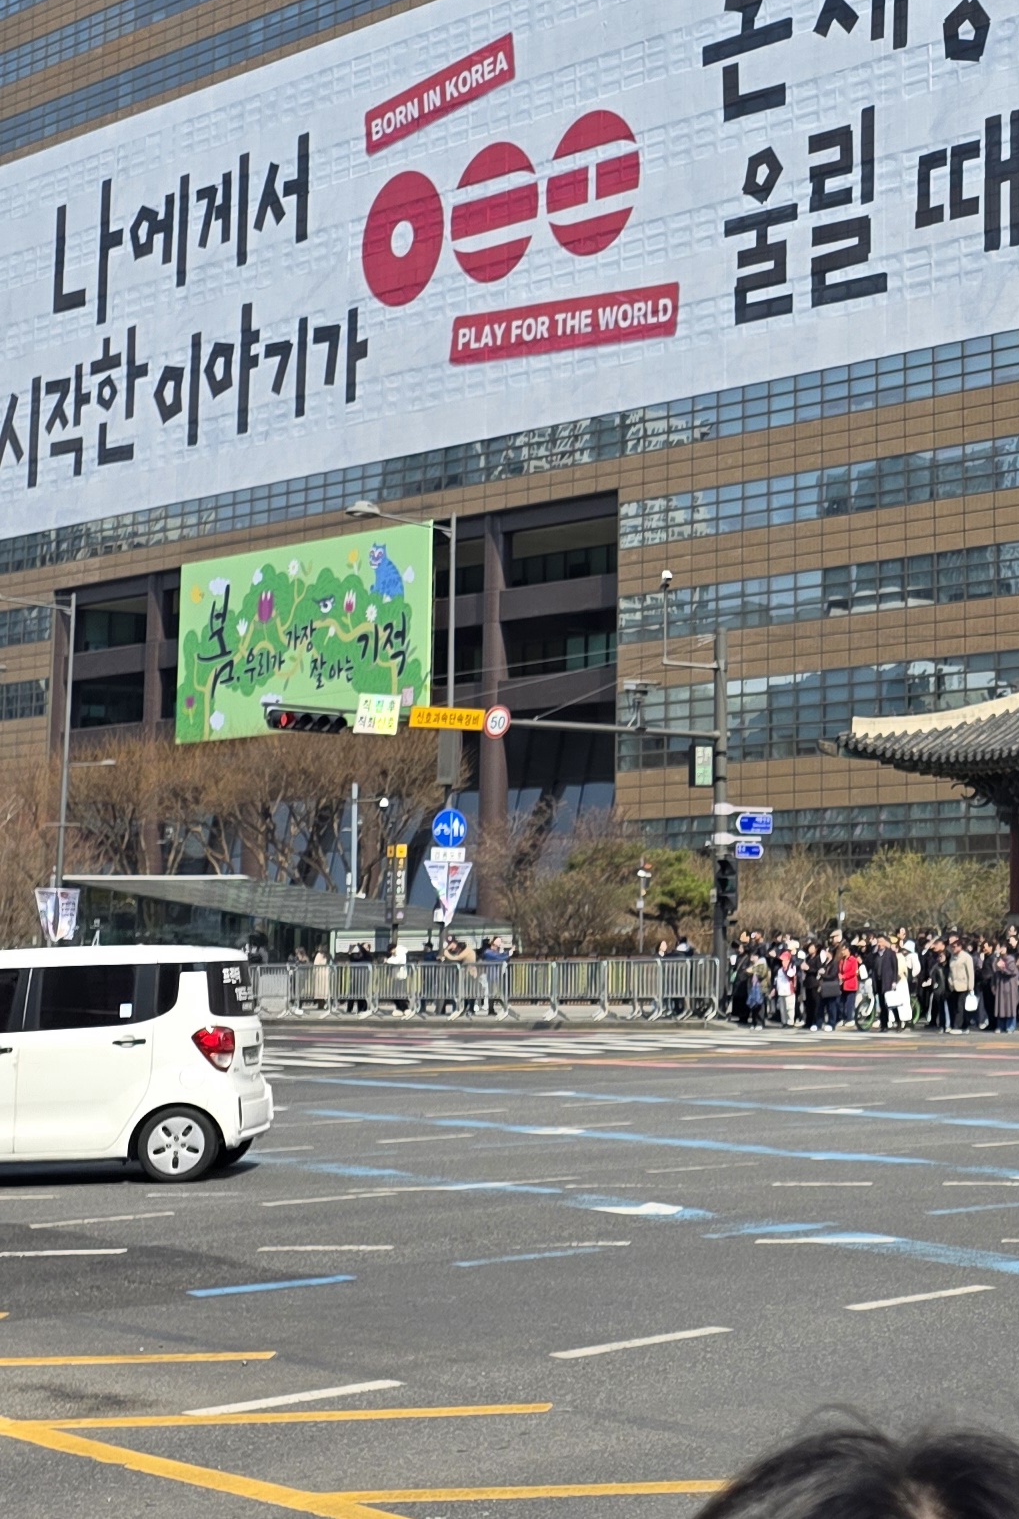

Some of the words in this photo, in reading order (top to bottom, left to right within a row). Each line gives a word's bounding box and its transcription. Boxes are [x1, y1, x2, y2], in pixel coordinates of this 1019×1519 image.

[371, 97, 420, 142] BORN
[423, 85, 441, 114] IN
[445, 50, 509, 102] KOREA
[53, 132, 310, 325] 나에게서
[724, 104, 889, 327] 울릴
[457, 321, 506, 351] PLAY
[510, 315, 550, 344] FOR
[554, 309, 593, 336] THE
[597, 297, 673, 331] WORLD
[0, 325, 149, 488] 시작한
[153, 302, 369, 446] 이야기가
[244, 647, 285, 685] 우리가
[285, 619, 317, 652] 가장
[356, 611, 407, 678] 기적
[489, 715, 506, 730] 50
